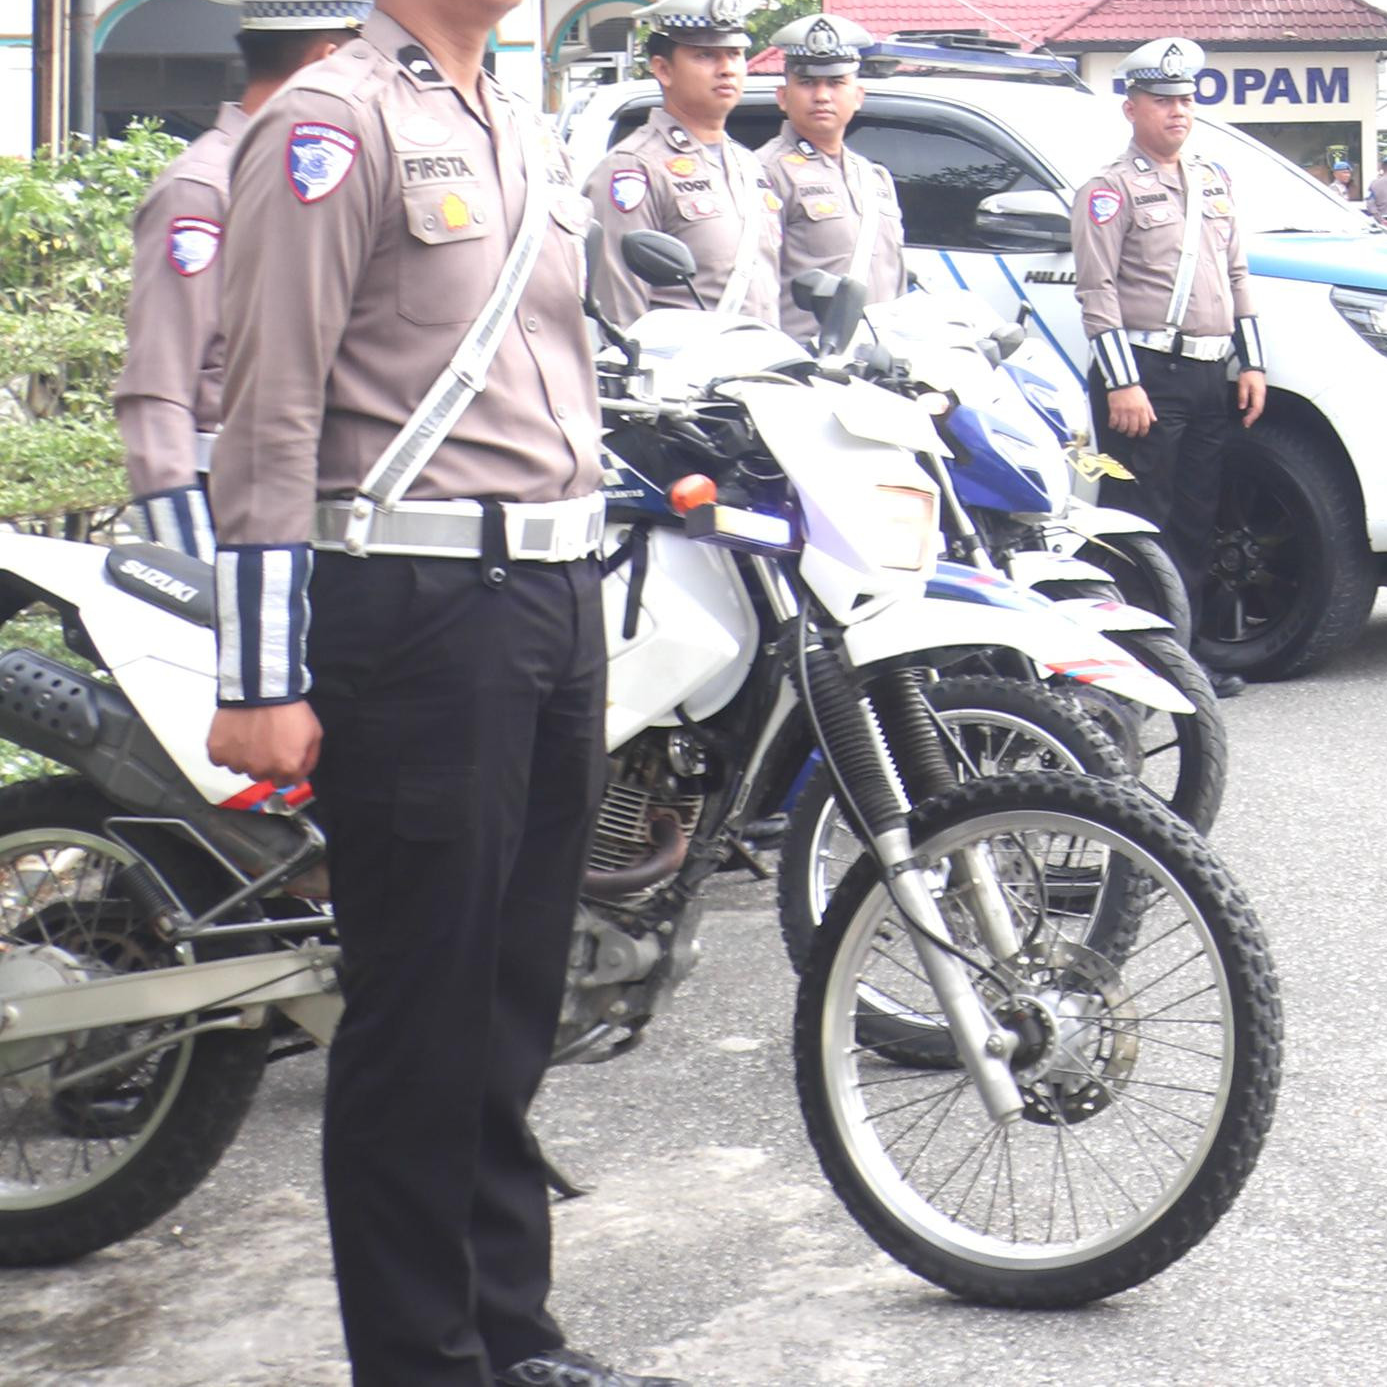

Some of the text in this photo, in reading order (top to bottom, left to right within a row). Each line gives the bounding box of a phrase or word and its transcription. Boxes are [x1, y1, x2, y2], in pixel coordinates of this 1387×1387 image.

[403, 157, 475, 182] FIRSTA
[673, 179, 713, 193] YOGY
[119, 559, 200, 603] SUZUKI
